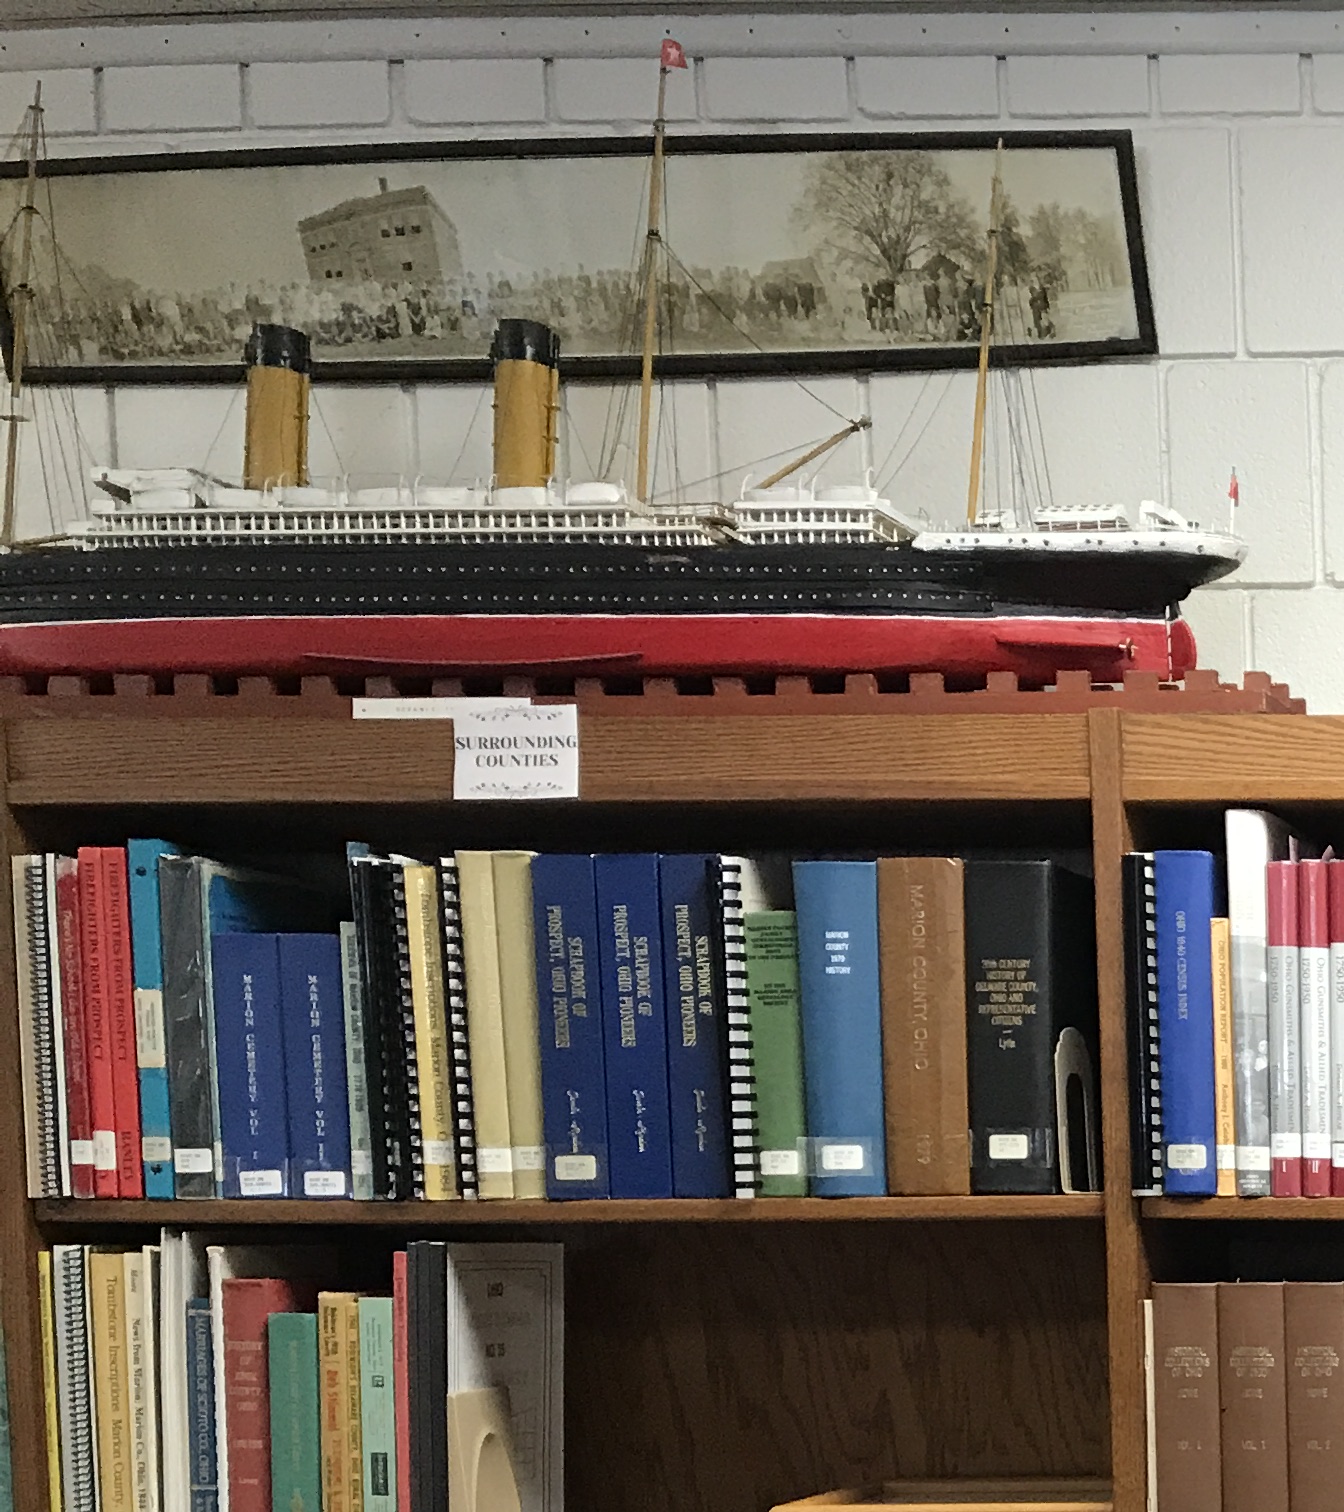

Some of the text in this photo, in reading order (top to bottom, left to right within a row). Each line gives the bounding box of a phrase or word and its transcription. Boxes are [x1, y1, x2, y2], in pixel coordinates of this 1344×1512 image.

[454, 735, 578, 750] SURROUNDING
[475, 752, 559, 768] COUNTIES
[83, 862, 103, 1062] FIREFIGHTERS FROM PROSPECT
[107, 862, 128, 1063] FIREFIGHTERS FROM PROSPECT
[545, 904, 570, 1049] PROSPECT, OHIO PIONEERS
[567, 936, 586, 1017] SCRAPBOOK OF
[612, 904, 637, 1049] PROSPECT, OHIO PIONEERS
[632, 936, 652, 1017] SCRAPBOOK OF
[675, 904, 697, 1049] PROSPECT, OHIO PIONEERS
[695, 936, 713, 1017] SCRAPBOOK OF
[909, 884, 930, 1071] MARION COUNTY, OHIO
[1270, 956, 1280, 1004] 1750-1950
[1301, 957, 1312, 1004] 1750-1950
[1316, 957, 1327, 983] OHIO
[244, 975, 257, 1027] MARION
[1317, 984, 1327, 1039] GUNSMITHS
[245, 1033, 259, 1102] CEMETERY
[247, 1108, 259, 1135] VOL
[1318, 1084, 1328, 1134] TRADESMEN
[119, 1130, 135, 1183] HANLEY
[106, 1275, 120, 1342] Tombstone
[112, 1417, 124, 1458] Marion
